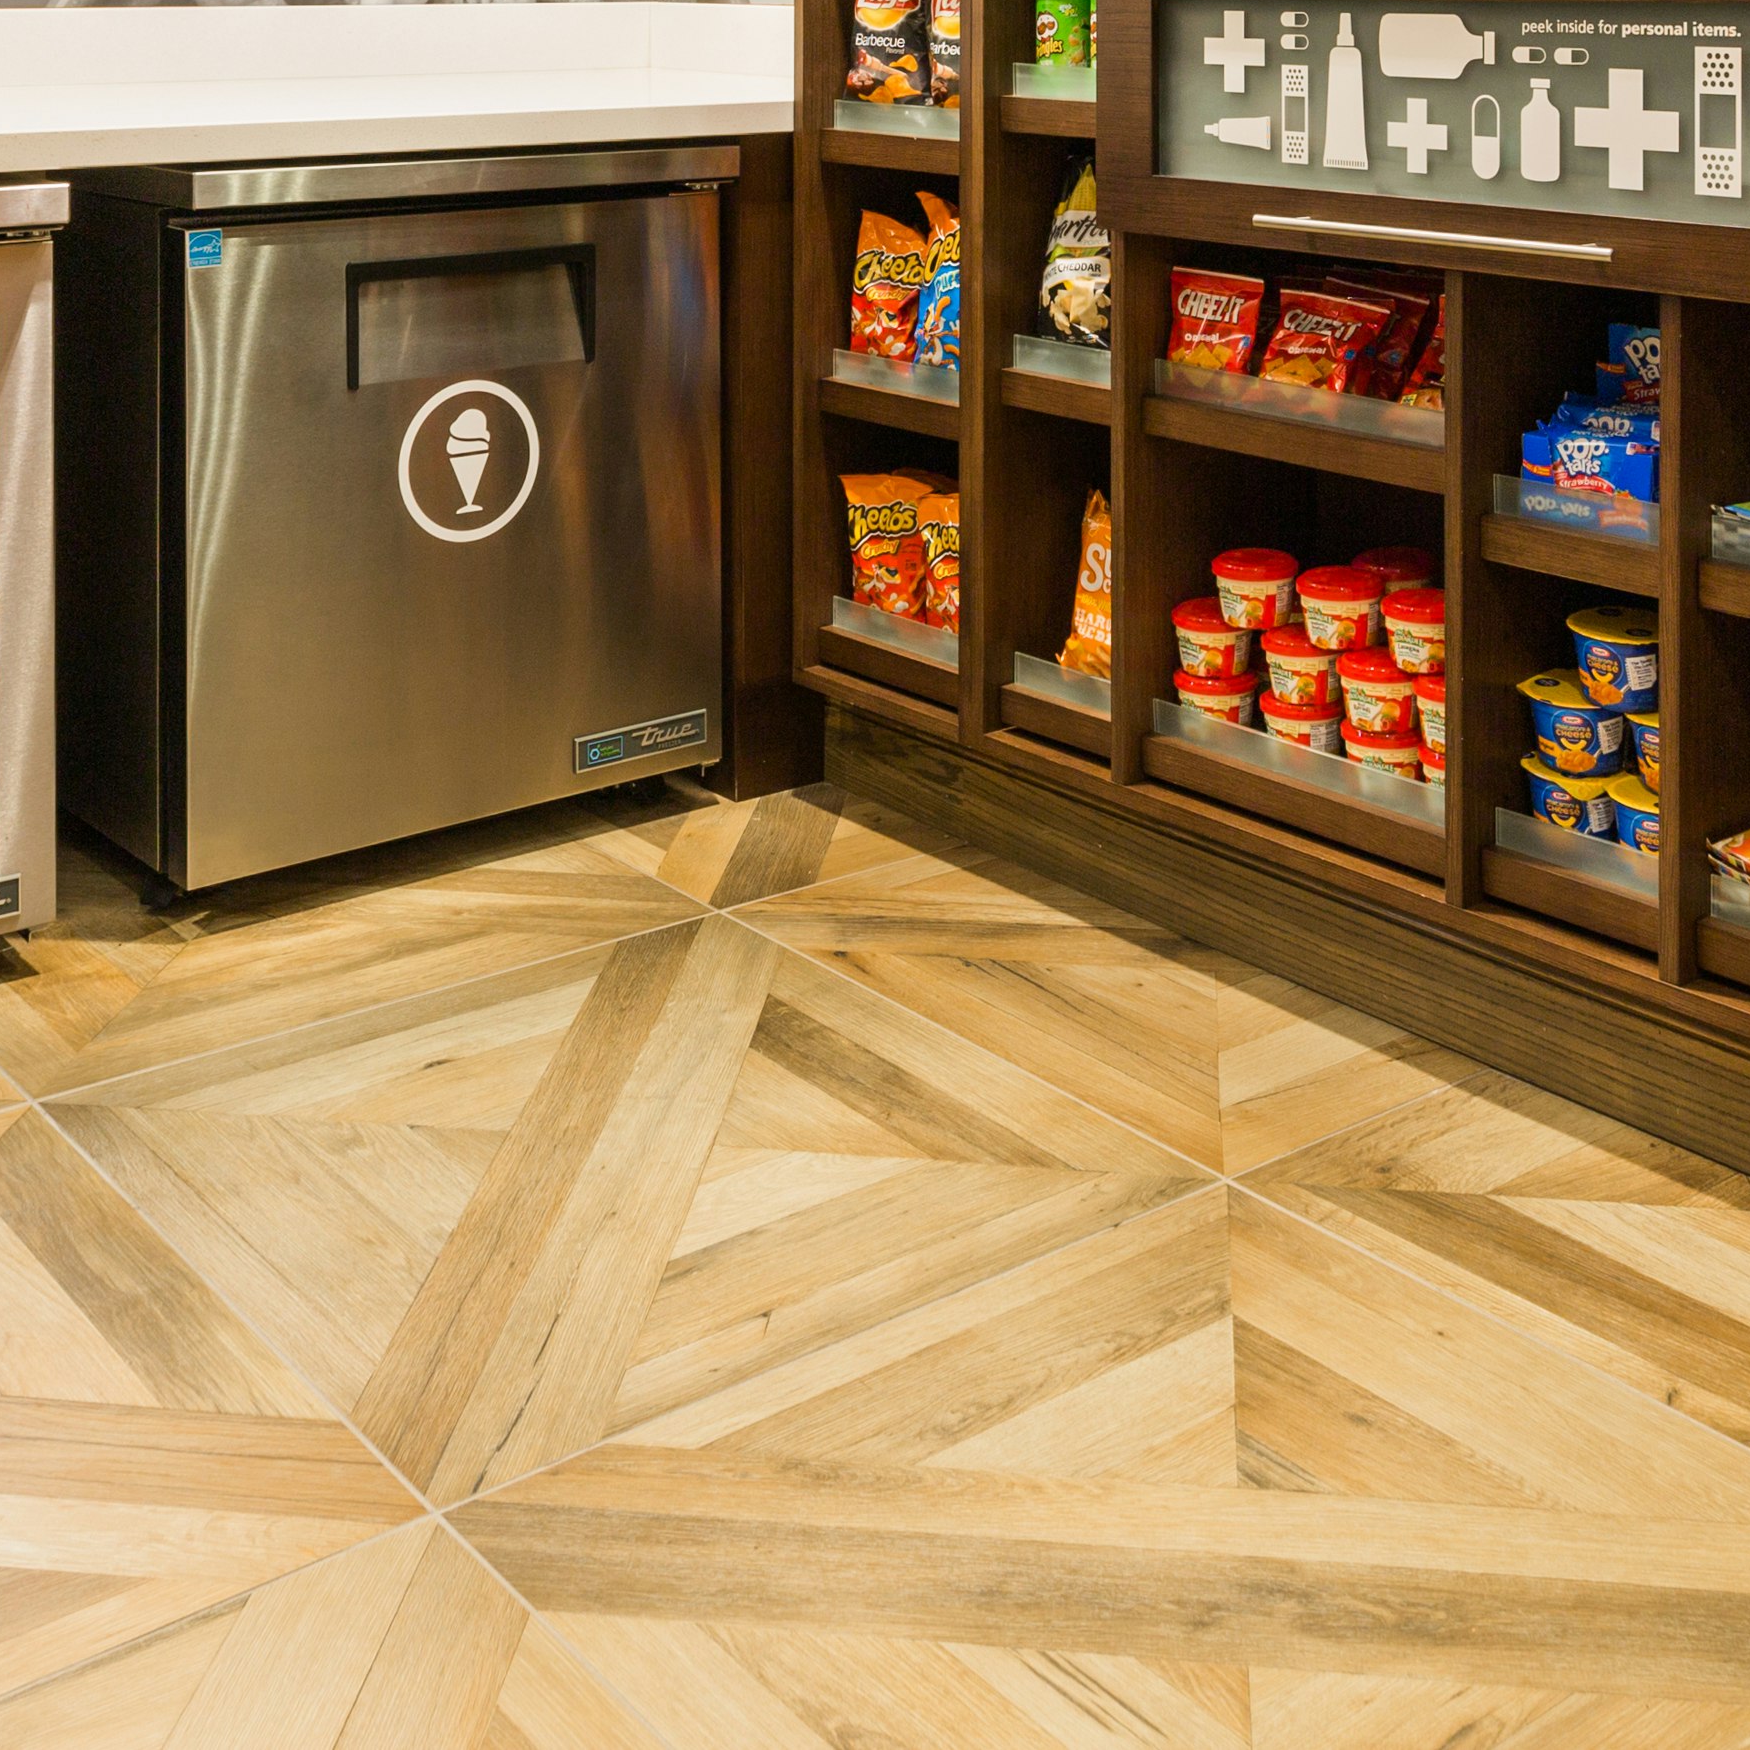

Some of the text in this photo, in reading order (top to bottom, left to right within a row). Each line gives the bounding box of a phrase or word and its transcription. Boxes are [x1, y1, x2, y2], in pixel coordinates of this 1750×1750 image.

[1522, 17, 1742, 39] peek inside for personal items.
[854, 32, 906, 49] Barbecue
[1057, 261, 1102, 274] CHEDDAR
[1558, 475, 1610, 492] Strawberry
[861, 539, 900, 559] Crunchy
[631, 721, 702, 749] true
[657, 738, 683, 750] FREEZER
